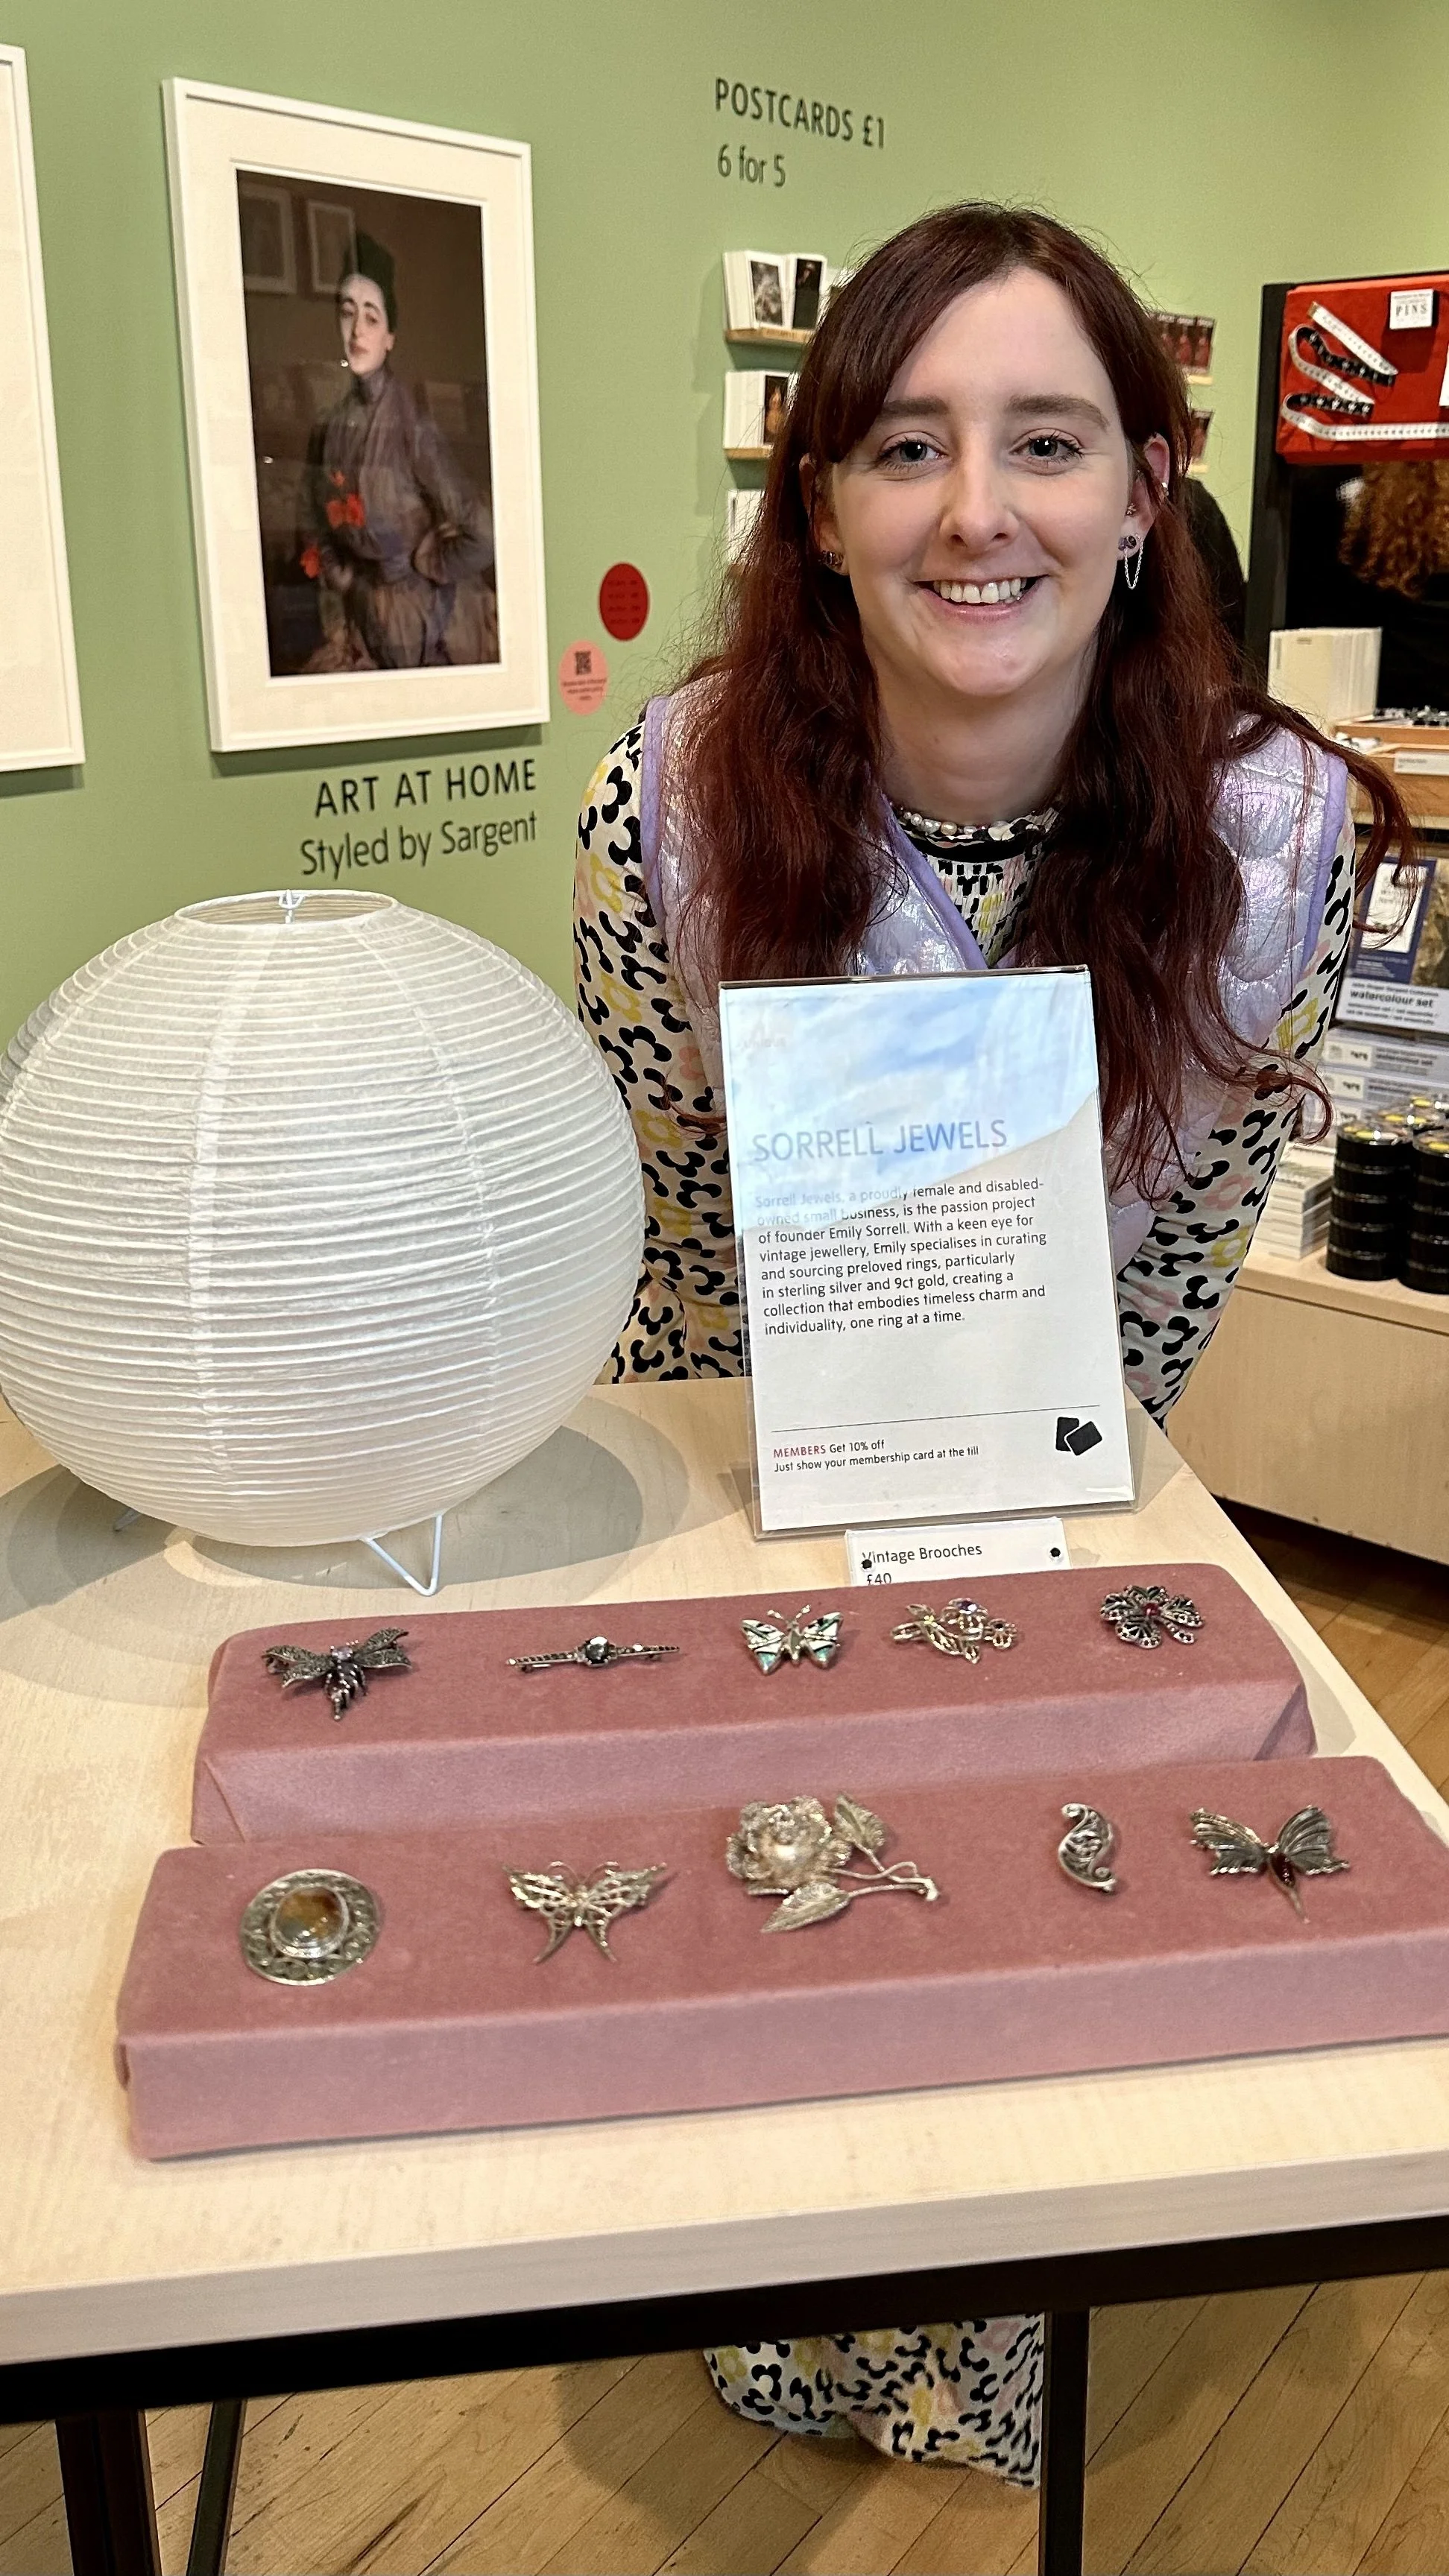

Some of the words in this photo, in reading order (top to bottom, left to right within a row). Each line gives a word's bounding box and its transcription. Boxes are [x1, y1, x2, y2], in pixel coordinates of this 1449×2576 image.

[716, 77, 854, 142] POSTCARDS
[863, 114, 884, 149] £1
[718, 144, 732, 177] 6
[739, 145, 767, 184] for
[773, 154, 786, 187] 5
[315, 776, 379, 818] ART
[395, 770, 432, 808] AT
[446, 759, 536, 800] HOME
[301, 827, 389, 880] Styled
[400, 825, 432, 867] by
[441, 811, 537, 857] Sargent
[753, 1129, 883, 1162] SORRELL
[894, 1119, 1008, 1153] JEWELS
[756, 1194, 795, 1207] Sorrell
[801, 1192, 845, 1205] Jewels,
[849, 1192, 856, 1202] a
[861, 1186, 908, 1203] proudly
[913, 1183, 955, 1197] female
[959, 1181, 982, 1194] and
[986, 1177, 1044, 1192] disabled-
[758, 1213, 799, 1226] owned
[804, 1209, 837, 1222] small
[842, 1206, 899, 1220] business,
[903, 1204, 912, 1216] is
[918, 1203, 936, 1215] the
[941, 1200, 988, 1216] passion
[993, 1196, 1035, 1212] project
[759, 1231, 771, 1244] of
[775, 1229, 825, 1243] founder
[830, 1225, 862, 1240] Emily
[866, 1223, 909, 1236] Sorrell.
[914, 1221, 942, 1233] With
[947, 1222, 953, 1231] a
[958, 1218, 987, 1230] keen
[991, 1218, 1012, 1230] eye
[1017, 1215, 1034, 1226] for
[760, 1250, 806, 1263] vintage
[810, 1244, 869, 1262] jewellery,
[874, 1241, 906, 1255] Emily
[911, 1237, 976, 1253] specialises
[981, 1235, 991, 1247] in
[997, 1232, 1046, 1245] curating
[762, 1267, 785, 1280] and
[789, 1265, 843, 1278] sourcing
[848, 1259, 902, 1276] preloved
[906, 1259, 941, 1271] rings,
[946, 1251, 1015, 1270] particularly
[763, 1285, 774, 1298] in
[779, 1283, 825, 1297] sterling
[830, 1281, 862, 1294] silver
[867, 1278, 890, 1291] and
[895, 1277, 913, 1289] 9ct
[918, 1273, 948, 1290] gold,
[953, 1271, 1002, 1285] creating
[1007, 1273, 1013, 1281] a
[764, 1303, 824, 1317] collection
[828, 1300, 853, 1312] that
[858, 1293, 920, 1310] embodies
[924, 1291, 975, 1305] timeless
[979, 1288, 1017, 1300] charm
[1022, 1285, 1046, 1298] and
[765, 1317, 846, 1335] individuality,
[850, 1318, 874, 1329] one
[878, 1315, 903, 1329] ring
[907, 1313, 918, 1325] at
[923, 1314, 929, 1323] a
[934, 1311, 965, 1323] time.
[773, 1445, 826, 1458] MEMBERS
[830, 1443, 845, 1453] Get
[850, 1441, 868, 1452] 10%
[871, 1440, 885, 1449] off
[774, 1462, 794, 1472] Just
[796, 1459, 821, 1469] show
[825, 1458, 846, 1469] your
[850, 1452, 911, 1466] membership
[913, 1449, 934, 1461] card
[937, 1449, 946, 1458] at
[948, 1447, 965, 1458] the
[967, 1446, 979, 1455] till
[862, 1551, 915, 1564] Vintage
[919, 1544, 982, 1560] Brooches
[866, 1573, 891, 1585] £40
